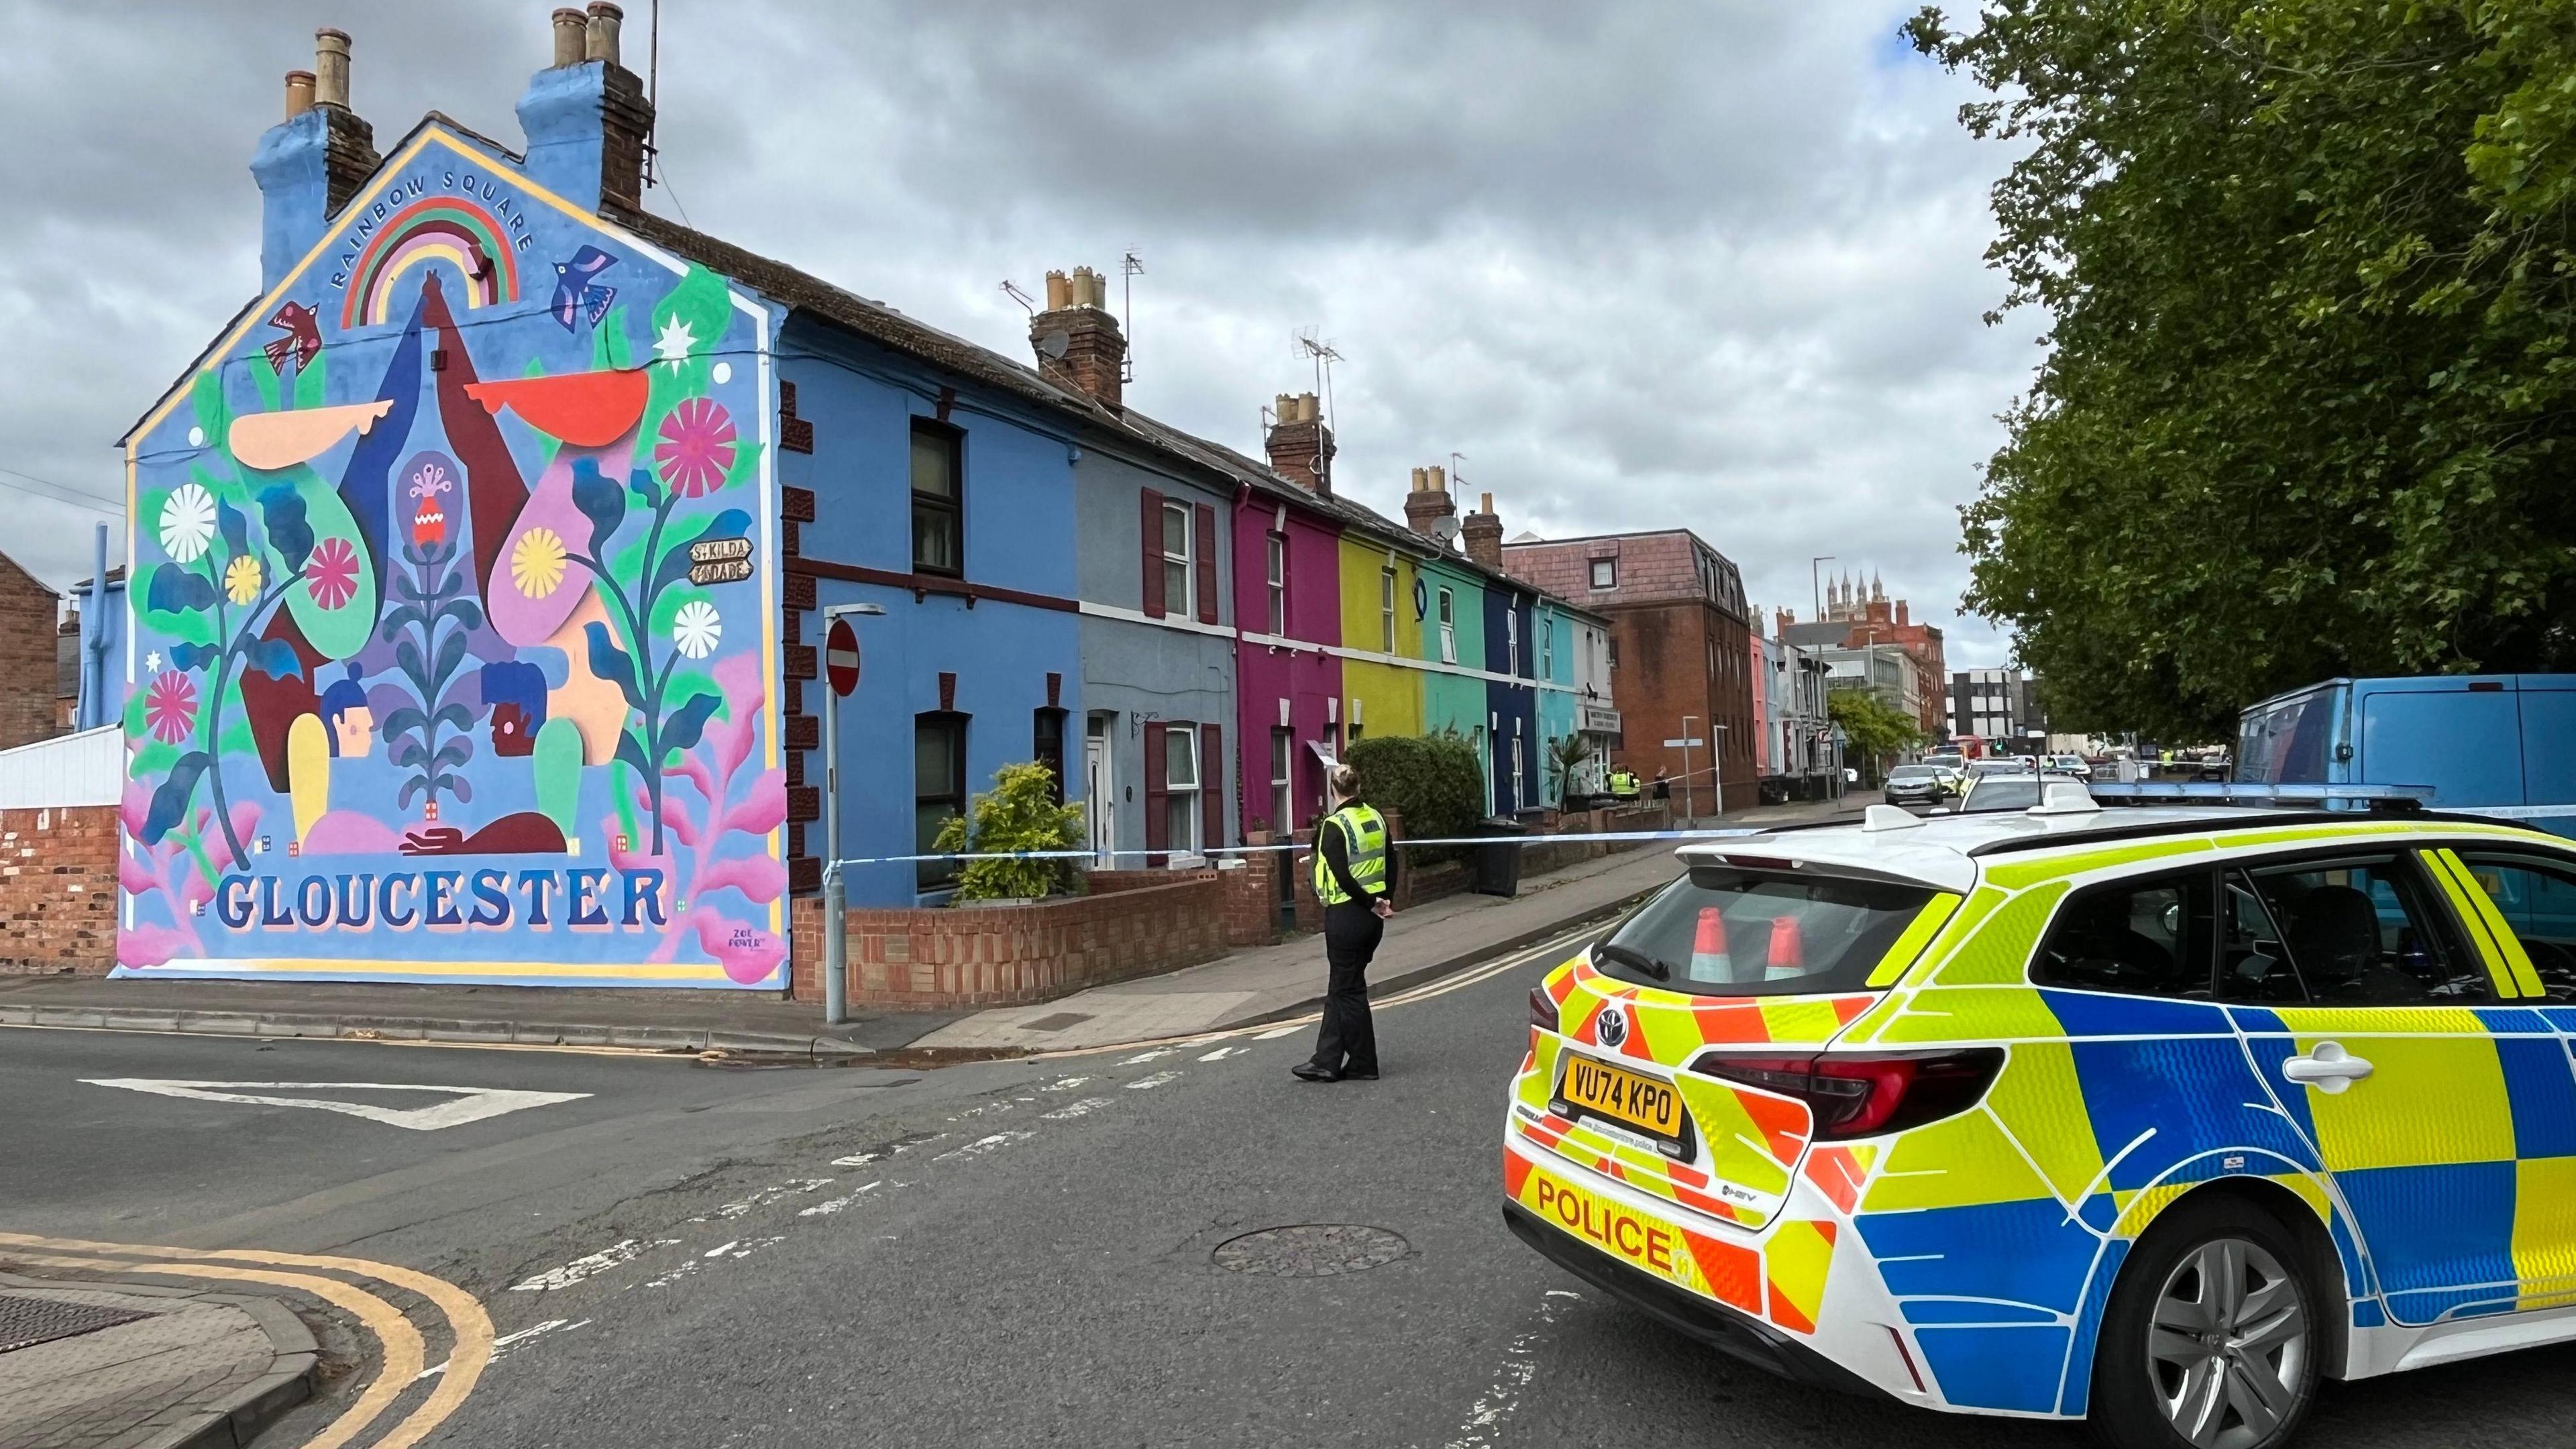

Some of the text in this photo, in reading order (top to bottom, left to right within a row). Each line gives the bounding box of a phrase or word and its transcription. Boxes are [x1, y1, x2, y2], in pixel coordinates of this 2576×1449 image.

[330, 170, 533, 289] RAINBOW SQUARE
[708, 540, 745, 559] KILDA
[216, 868, 667, 932] GLOUCESTER
[733, 928, 752, 938] ZOE
[1576, 1063, 1671, 1125] VU74 KPO
[1538, 1177, 1673, 1273] POLICE
